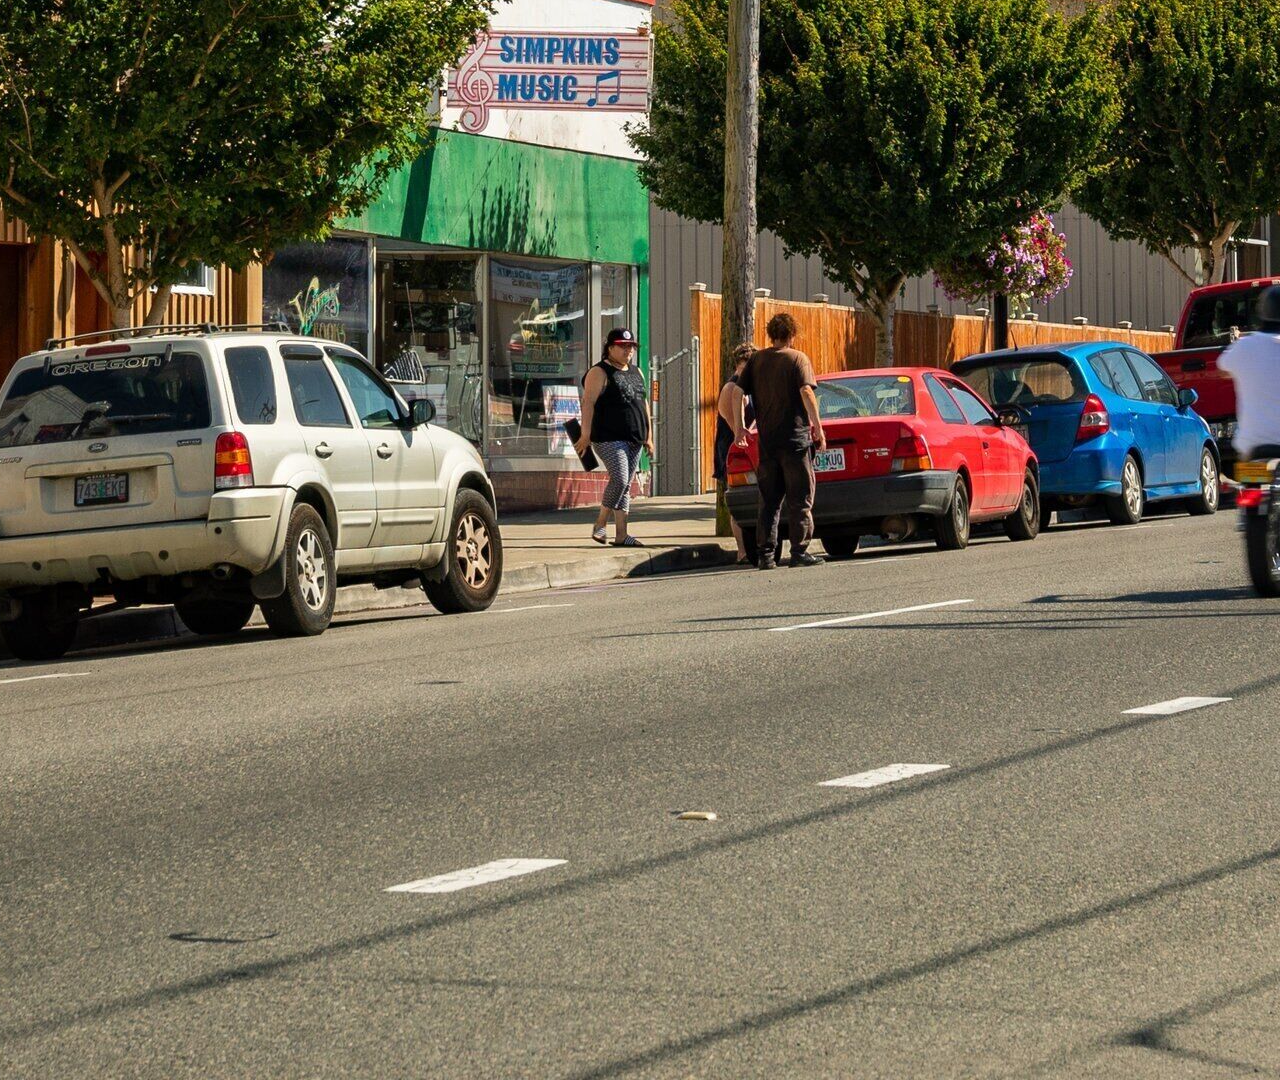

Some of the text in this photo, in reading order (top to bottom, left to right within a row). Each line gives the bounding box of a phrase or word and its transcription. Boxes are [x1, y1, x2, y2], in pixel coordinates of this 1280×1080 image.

[499, 35, 621, 66] SIMPKINS
[497, 74, 579, 102] MUSIC
[51, 355, 162, 377] OREGON
